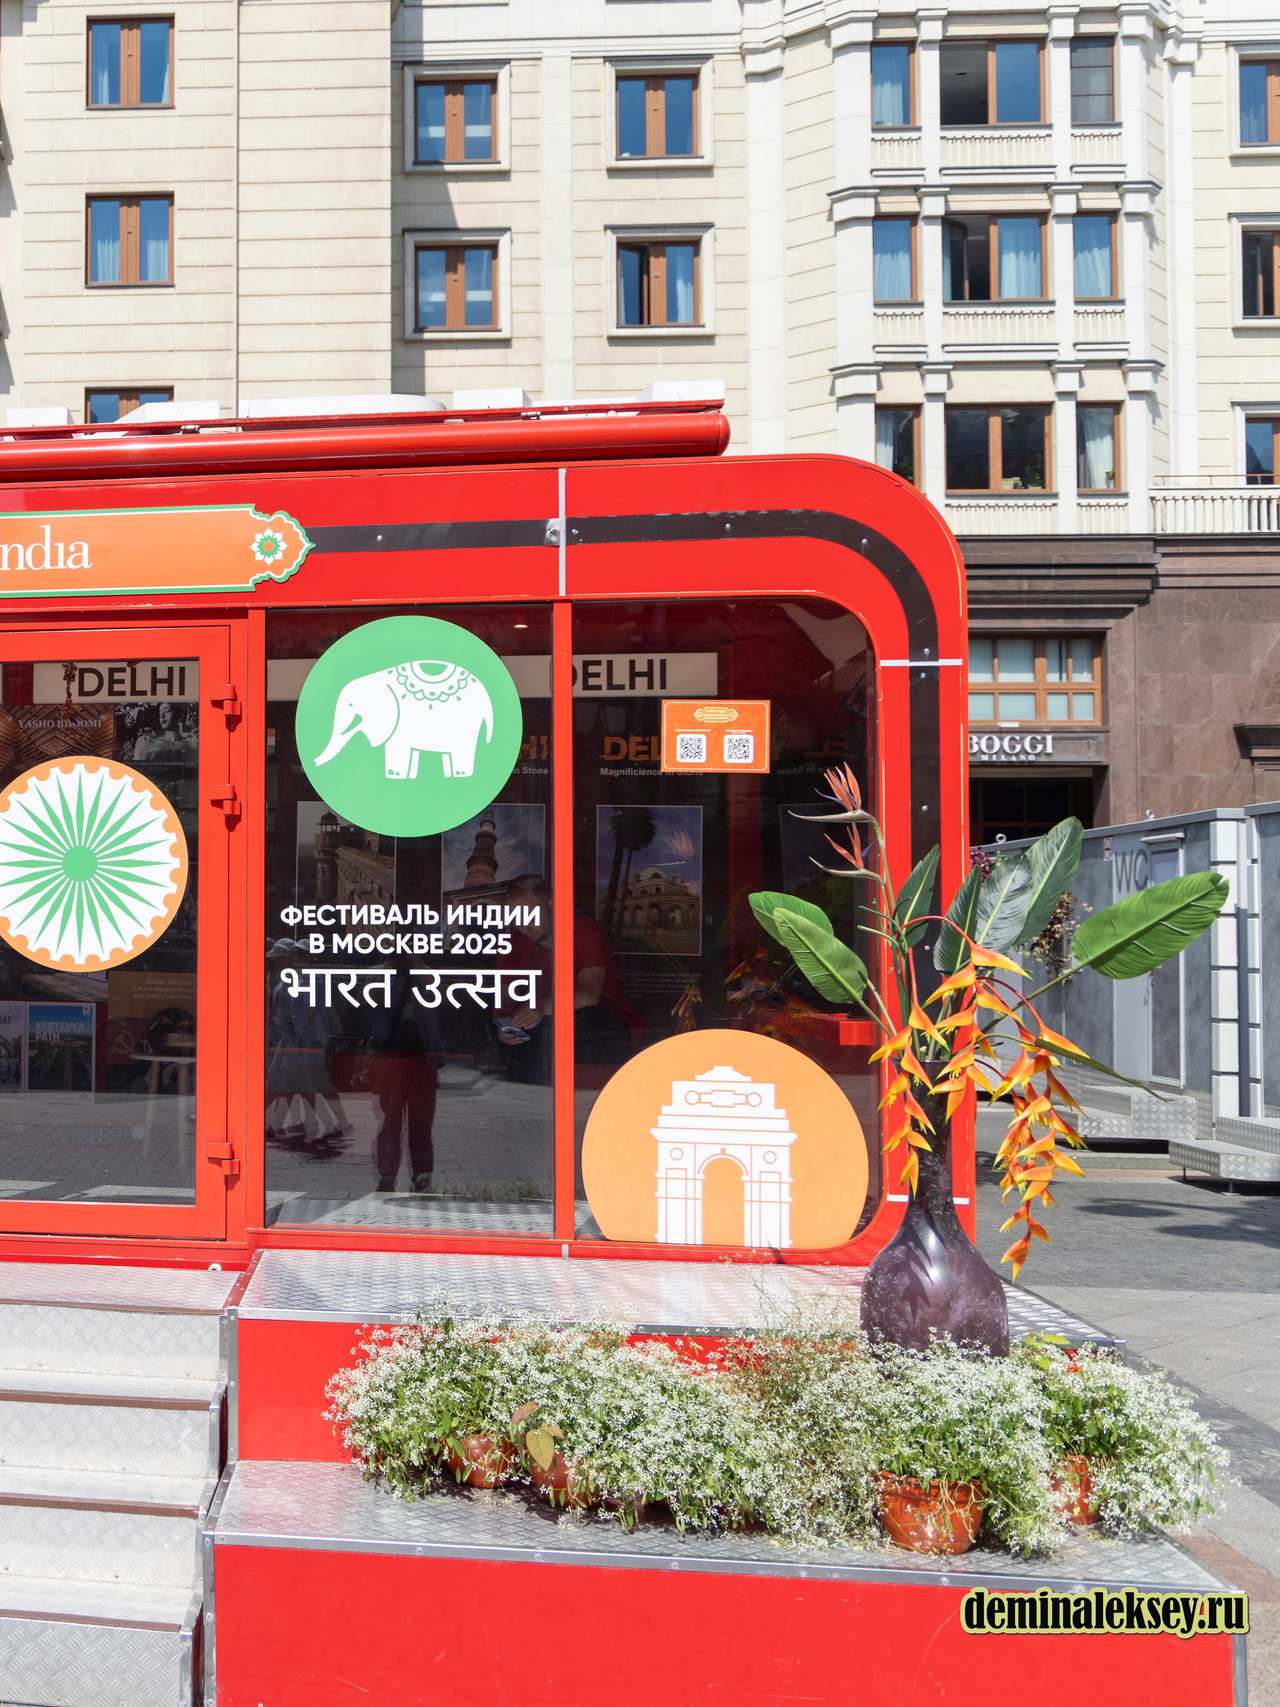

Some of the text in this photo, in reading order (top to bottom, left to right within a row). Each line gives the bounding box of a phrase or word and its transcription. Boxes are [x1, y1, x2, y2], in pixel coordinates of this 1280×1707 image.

[78, 666, 186, 697] DELHI
[18, 719, 55, 728] YASHO
[969, 735, 1054, 754] BOGGI
[523, 766, 549, 774] Stone
[1114, 848, 1148, 894] WC
[280, 904, 541, 931] ФЕСТИВАЛЬ ИНДИИ
[309, 933, 512, 955] В МОСКВЕ 2025
[280, 968, 543, 1009] भारत उत्सव
[35, 1021, 85, 1033] KARTAVYA
[35, 1032, 60, 1042] PATH
